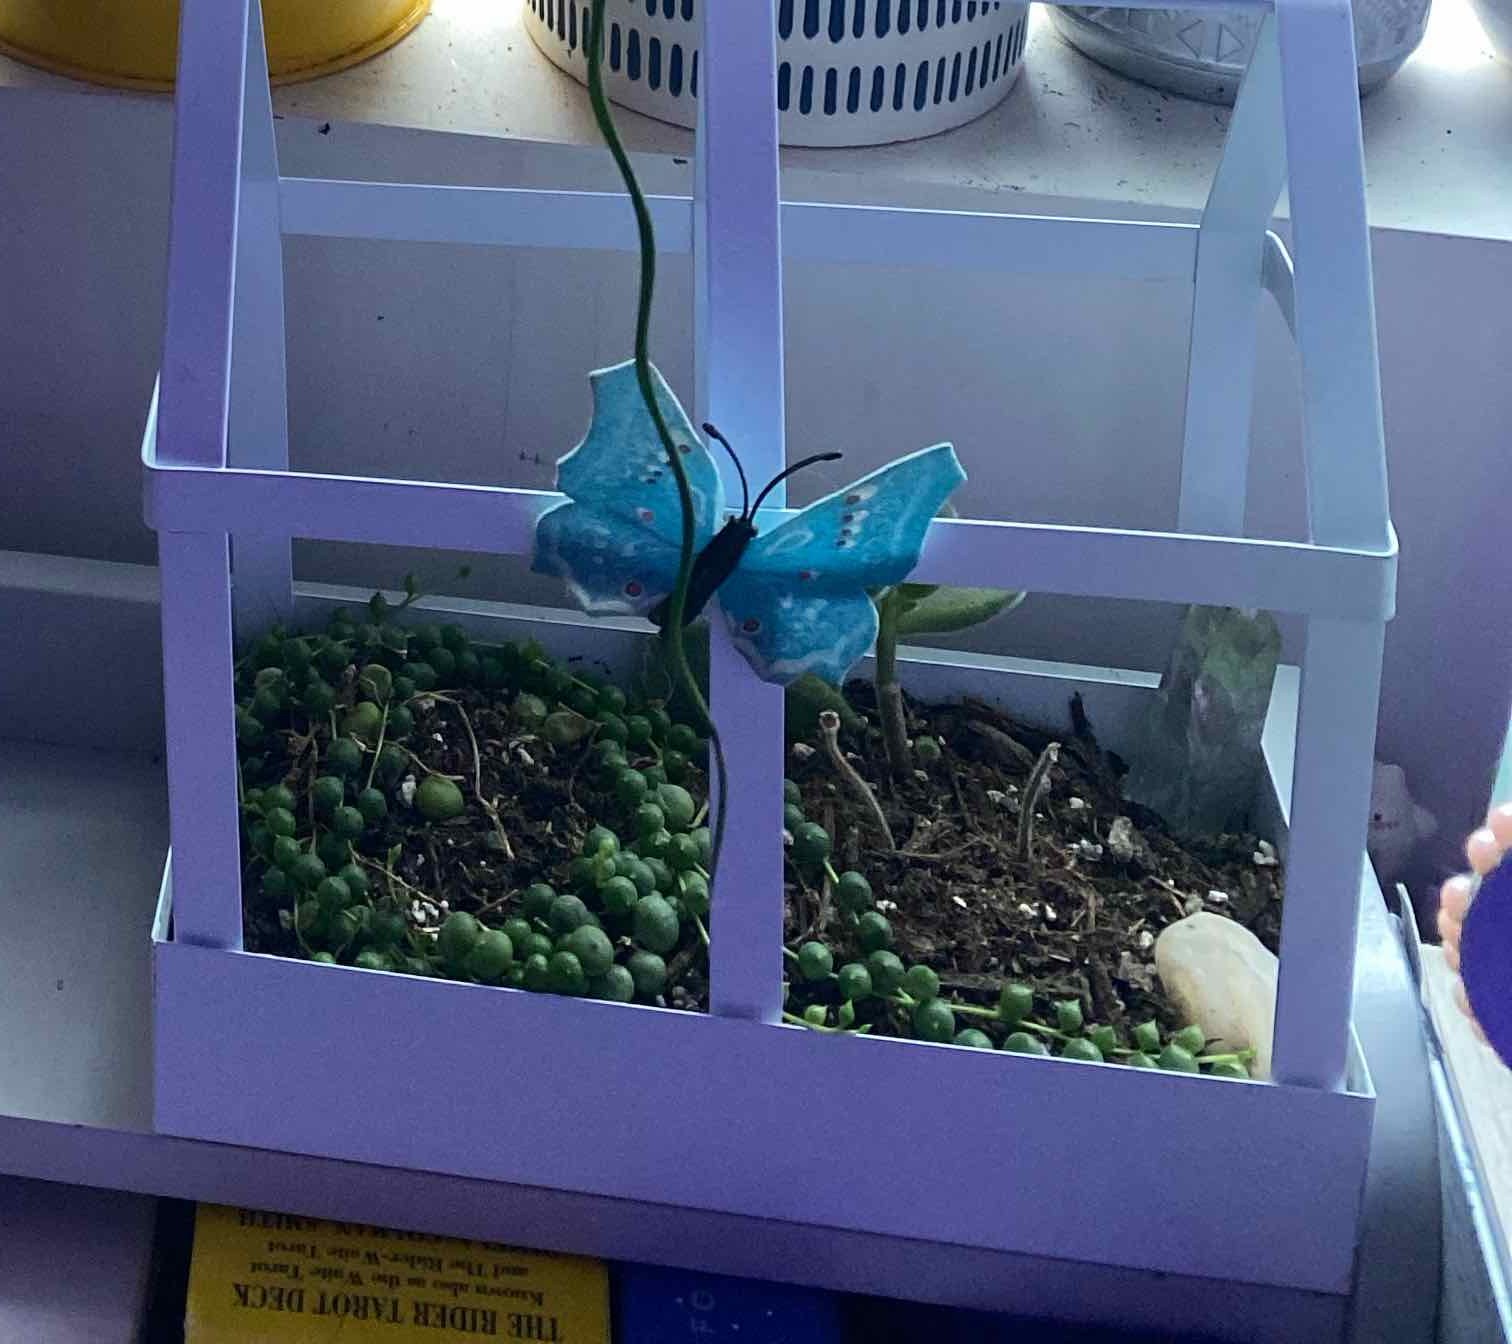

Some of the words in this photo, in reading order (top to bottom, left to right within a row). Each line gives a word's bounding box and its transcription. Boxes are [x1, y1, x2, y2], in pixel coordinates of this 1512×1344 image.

[267, 1240, 321, 1260] Tarot
[326, 1246, 443, 1273] Rider-Waite
[249, 1261, 302, 1281] Tarot
[310, 1266, 364, 1286] Waite
[233, 1282, 304, 1312] DECK
[315, 1291, 402, 1324] TAROT
[414, 1300, 498, 1336] RIDER
[507, 1312, 561, 1343] THE
